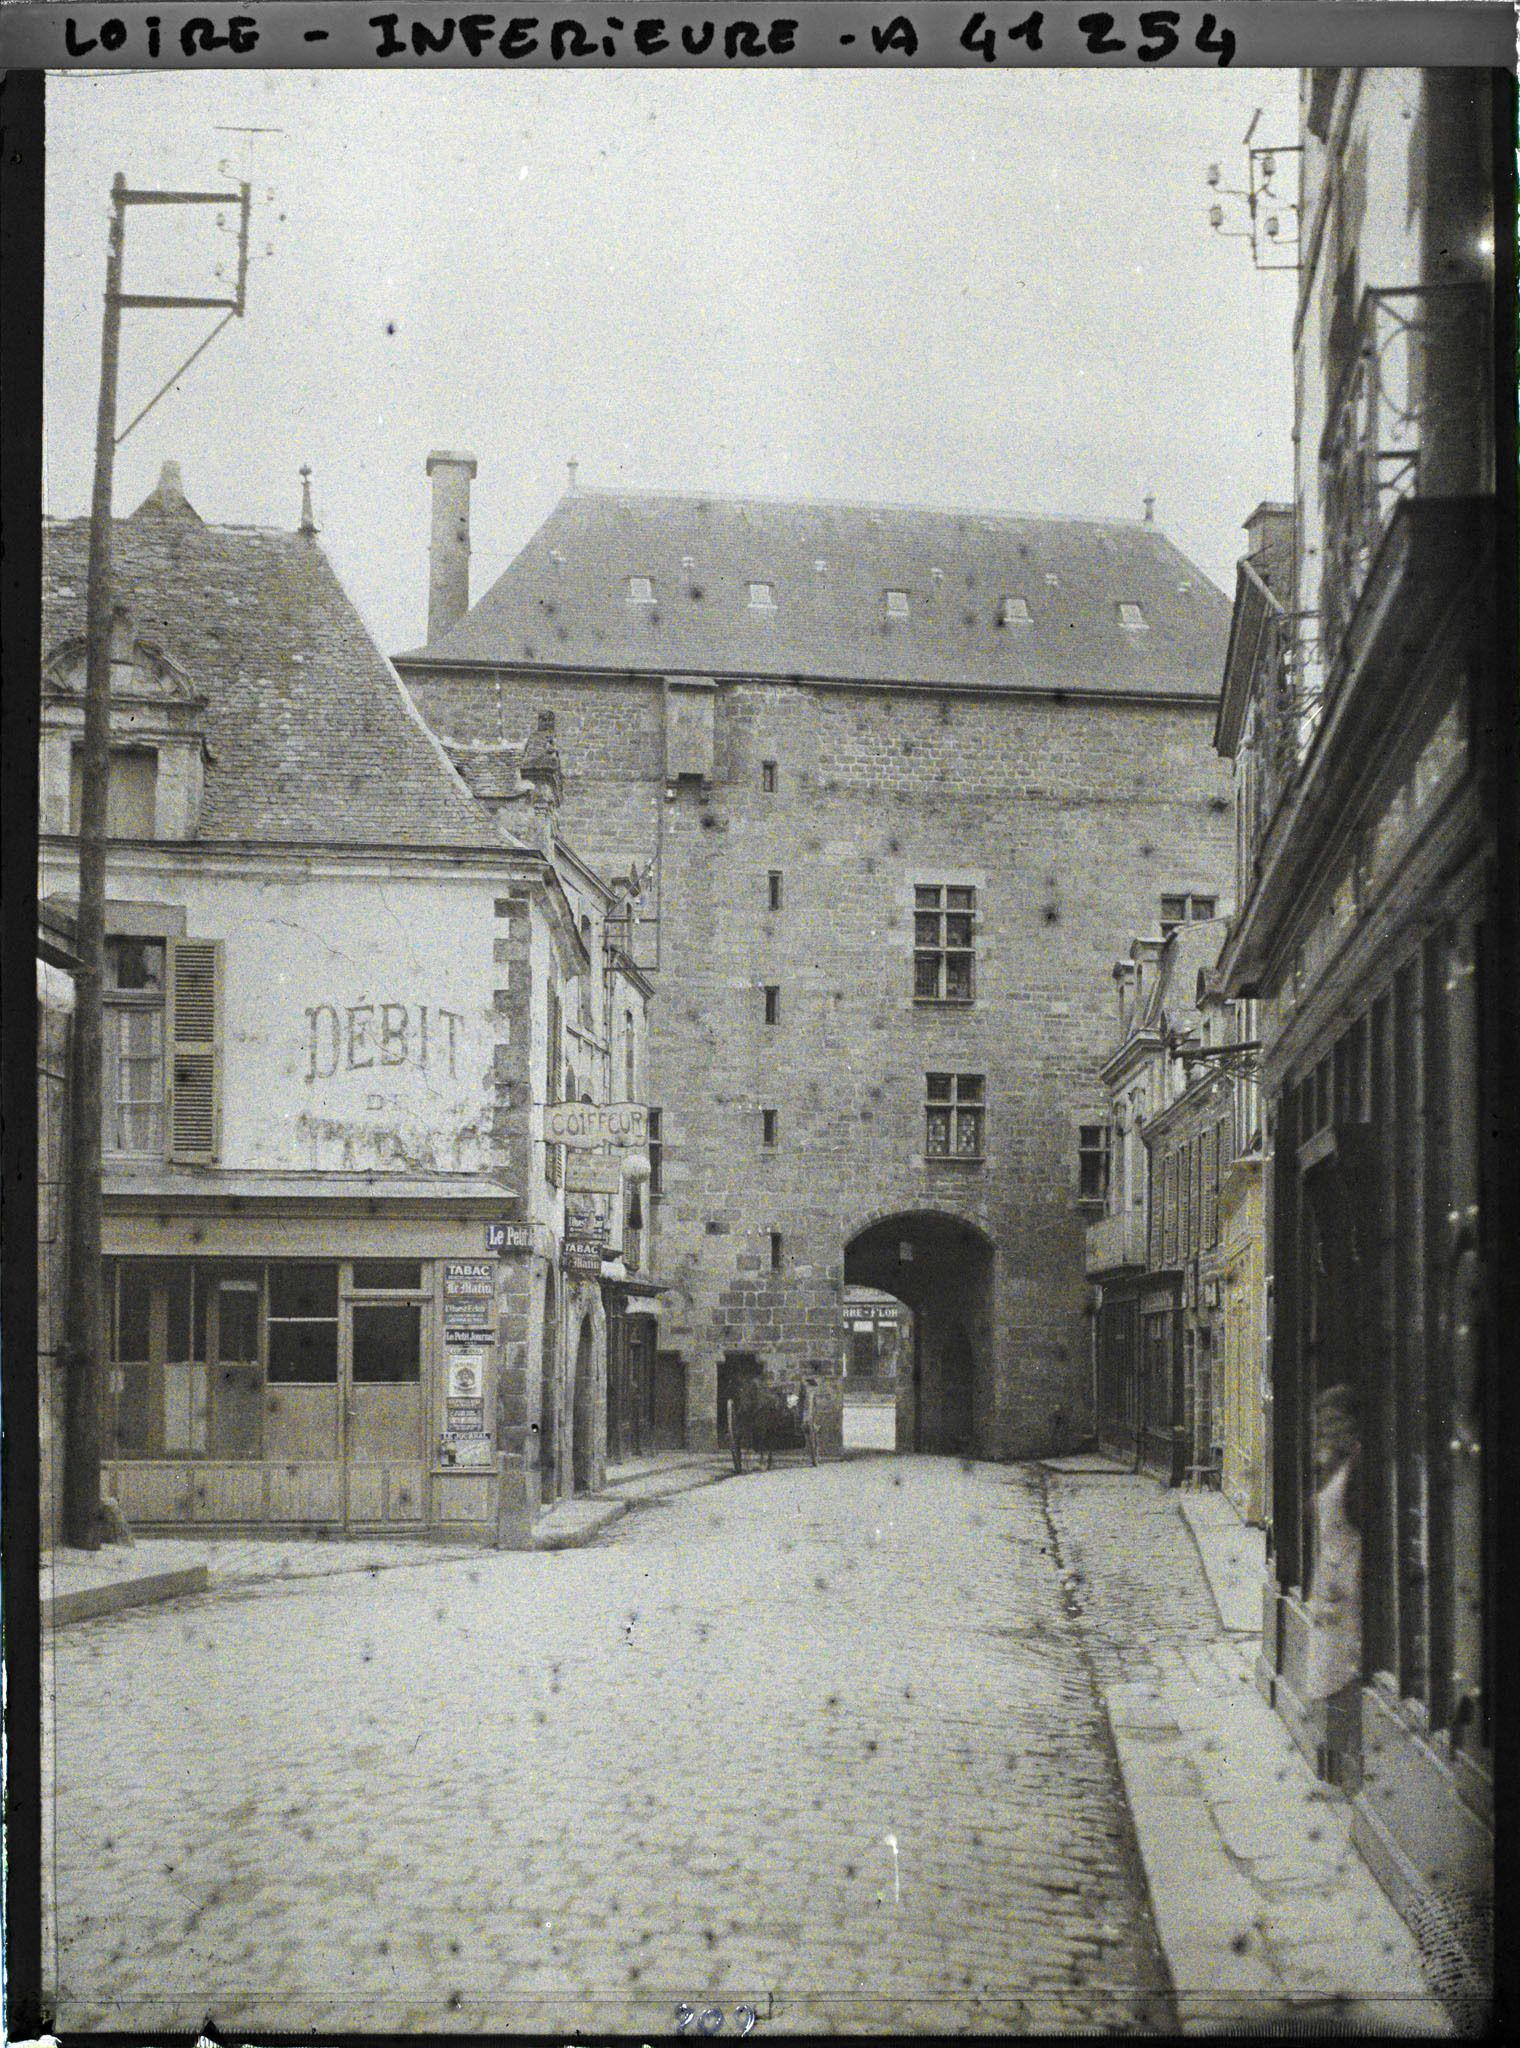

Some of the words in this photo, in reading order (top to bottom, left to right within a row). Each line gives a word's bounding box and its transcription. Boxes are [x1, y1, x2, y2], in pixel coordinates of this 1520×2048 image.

[959, 10, 1044, 63] 41
[1077, 10, 1237, 68] 254
[489, 1225, 504, 1246] Le
[564, 1243, 599, 1254] TABAC
[448, 1265, 490, 1276] TABAC
